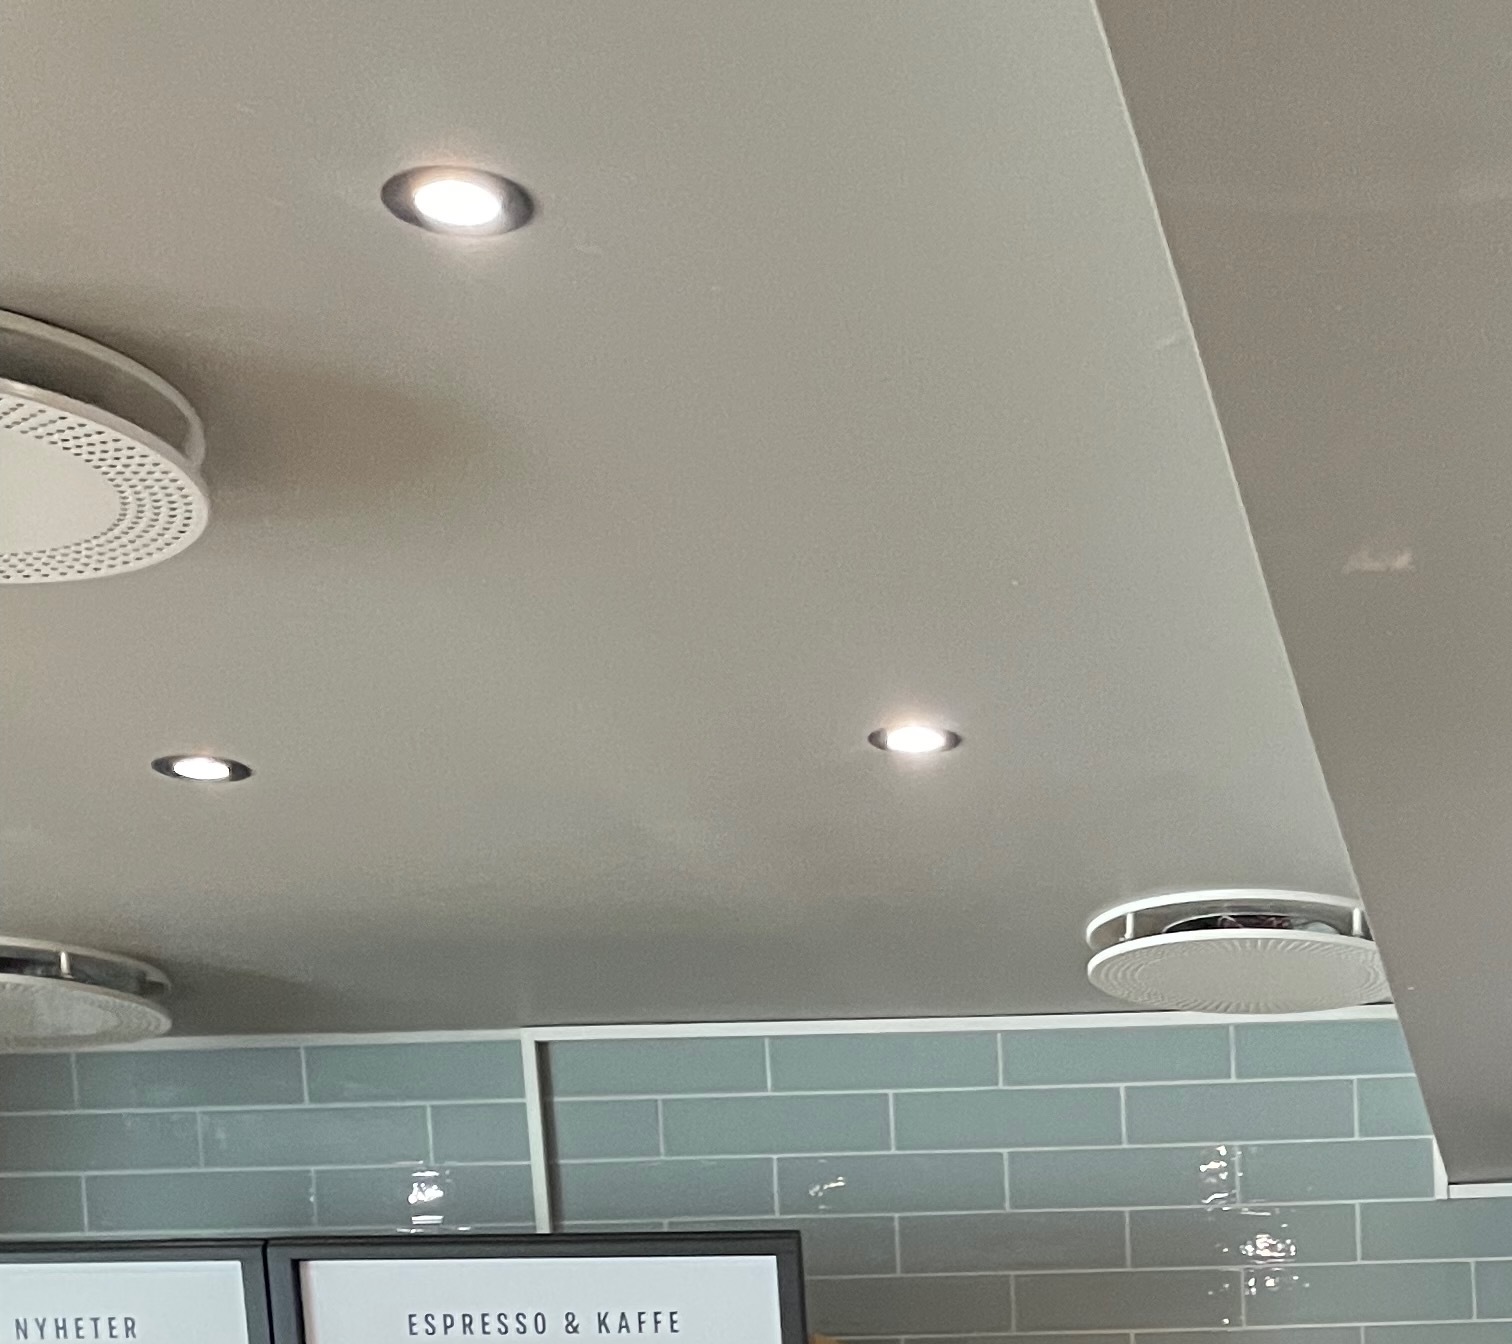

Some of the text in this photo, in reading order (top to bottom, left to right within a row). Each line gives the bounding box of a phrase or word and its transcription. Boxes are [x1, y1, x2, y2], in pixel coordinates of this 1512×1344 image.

[15, 1316, 138, 1340] NYHETER
[408, 1311, 681, 1336] ESPRESSO & KAFFE
